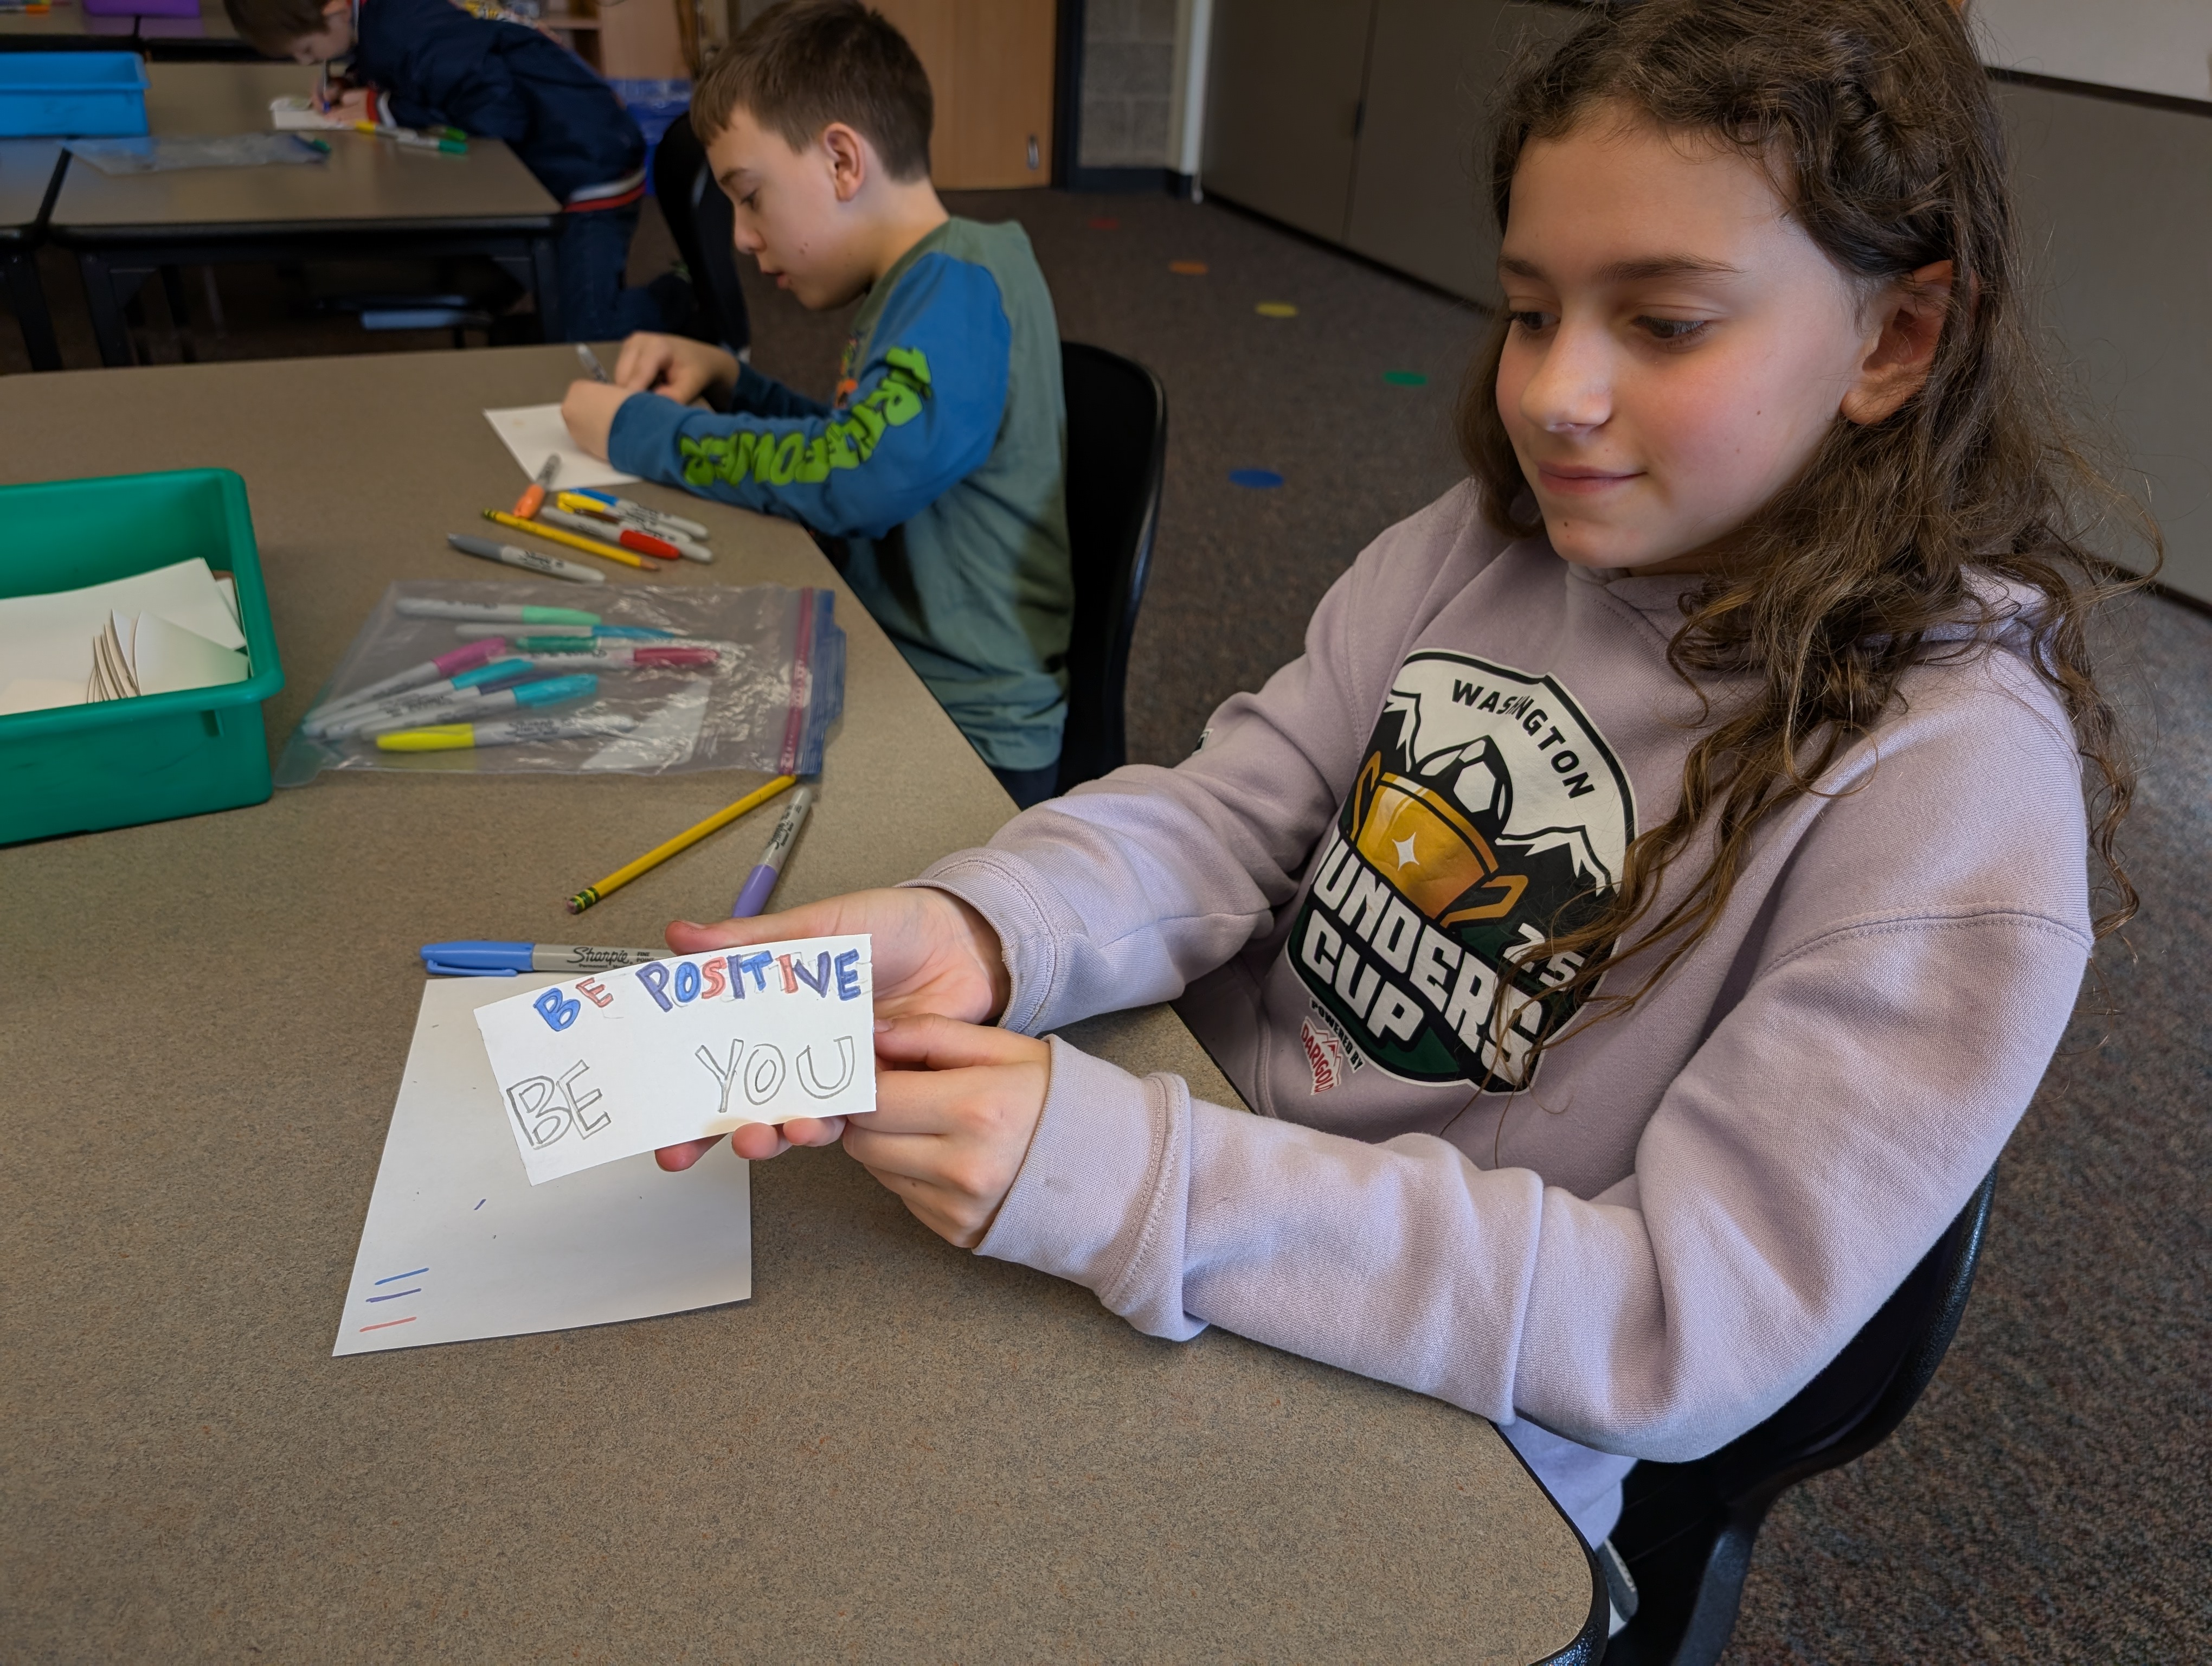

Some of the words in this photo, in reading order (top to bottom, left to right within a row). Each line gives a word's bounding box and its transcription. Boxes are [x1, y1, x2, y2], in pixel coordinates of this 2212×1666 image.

[680, 431, 831, 486] POWER
[826, 345, 932, 469] TRTLE
[1452, 678, 1595, 799] WASHNGTON
[533, 977, 614, 1031] BE
[635, 948, 861, 1012] POSITIVE
[1301, 909, 1425, 1042] CUP
[1310, 824, 1543, 1085] UNDERS
[506, 1059, 612, 1150] BE
[695, 1035, 855, 1113] YOU
[1311, 999, 1353, 1054] POWERED
[1350, 1050, 1364, 1071] BY
